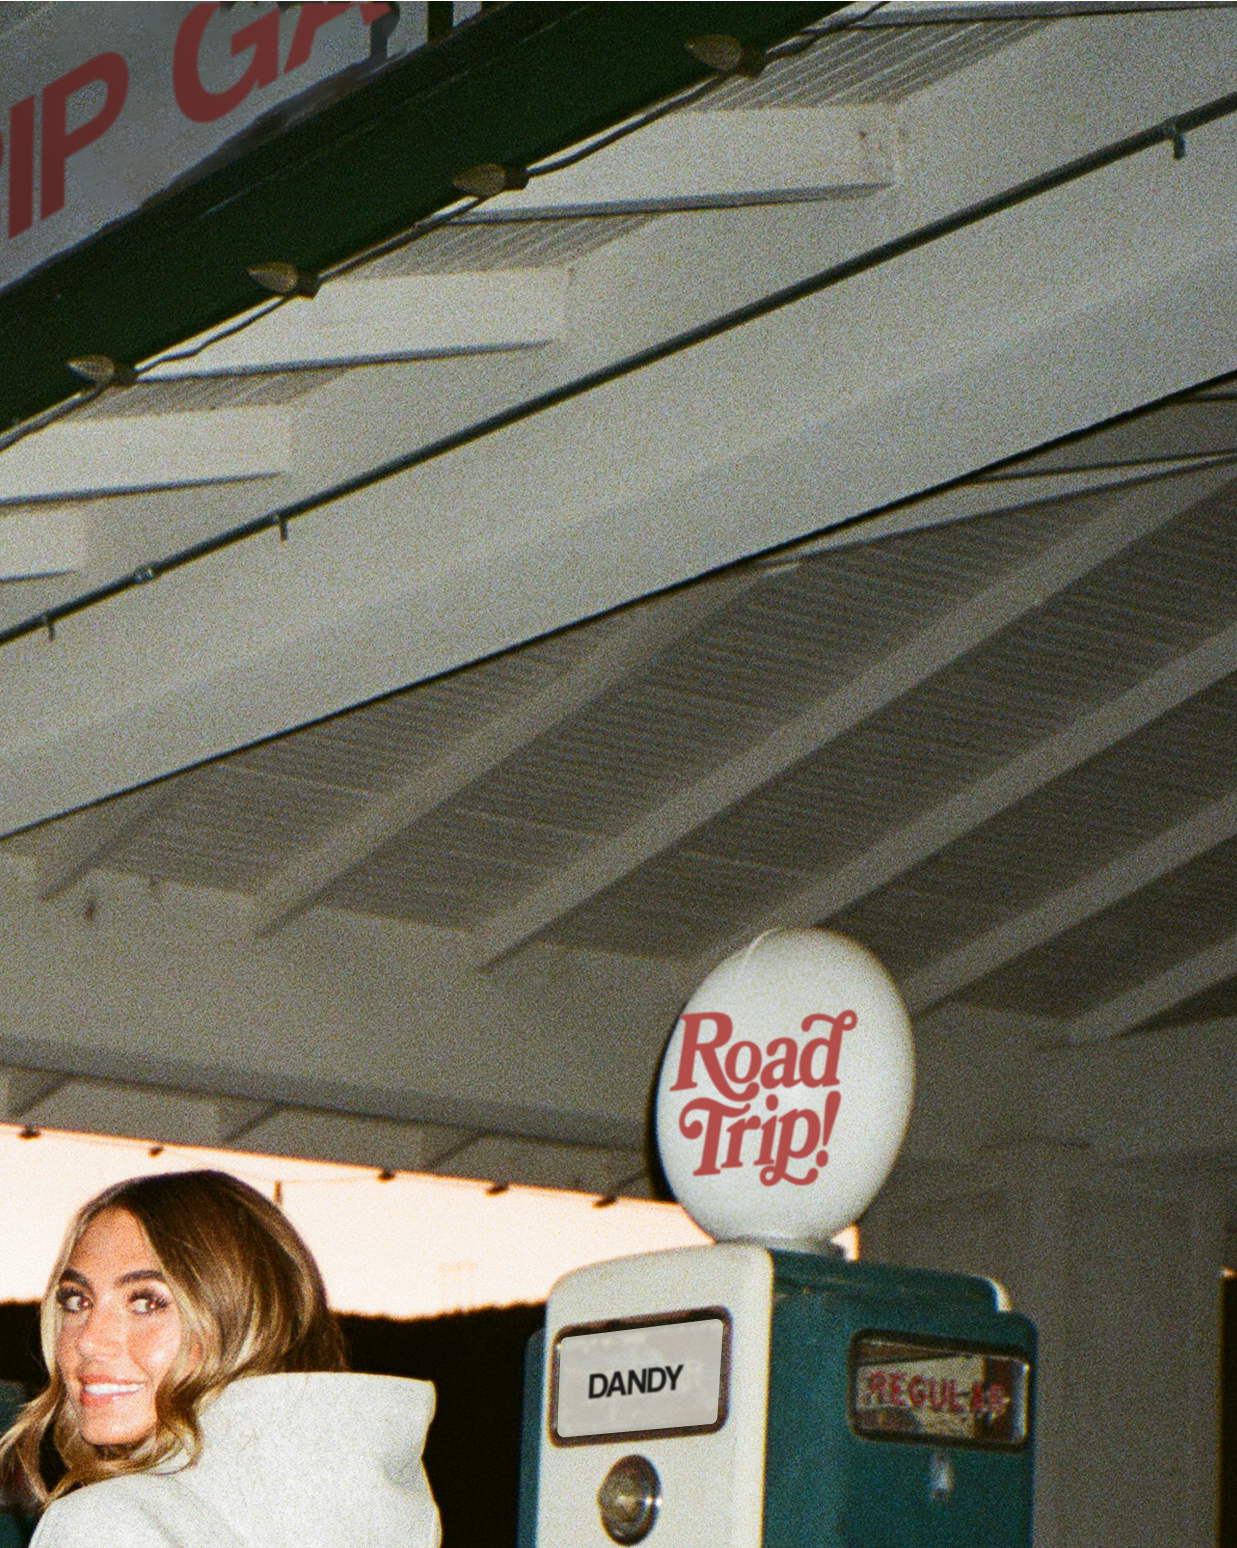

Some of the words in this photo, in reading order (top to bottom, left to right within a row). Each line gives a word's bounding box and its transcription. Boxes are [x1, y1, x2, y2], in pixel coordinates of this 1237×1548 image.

[669, 1010, 857, 1101] Road
[678, 1090, 841, 1187] Trip!
[587, 1364, 684, 1400] DANDY
[868, 1371, 1006, 1417] REGULAR
